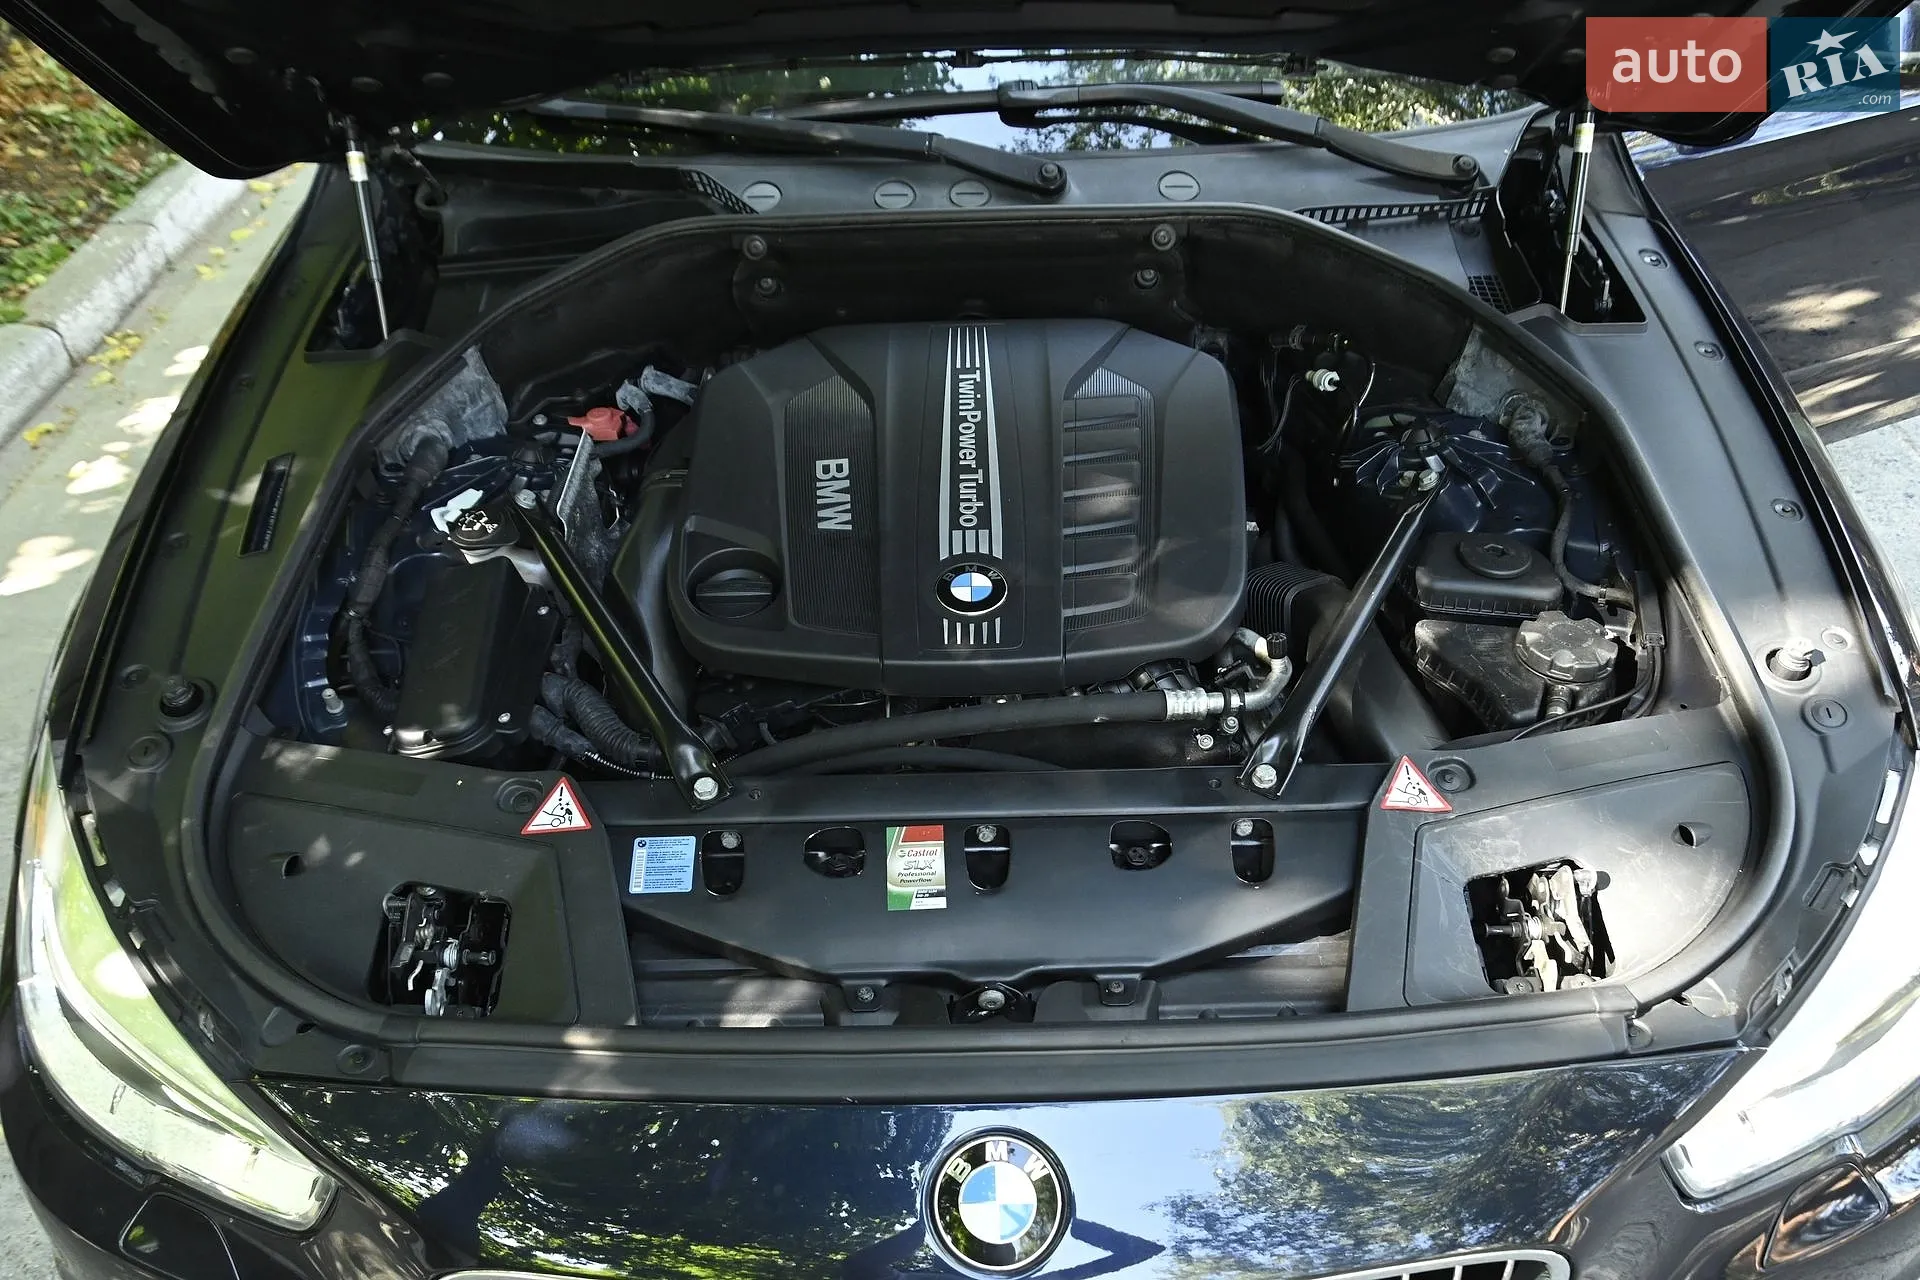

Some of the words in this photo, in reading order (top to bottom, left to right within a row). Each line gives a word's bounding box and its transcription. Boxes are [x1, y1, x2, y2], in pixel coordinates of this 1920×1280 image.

[958, 369, 982, 468] TwinPower
[815, 458, 853, 531] BMW
[958, 469, 984, 528] Turbo
[897, 870, 937, 878] Professional
[907, 849, 938, 858] Castrol
[946, 1139, 1050, 1184] BMW
